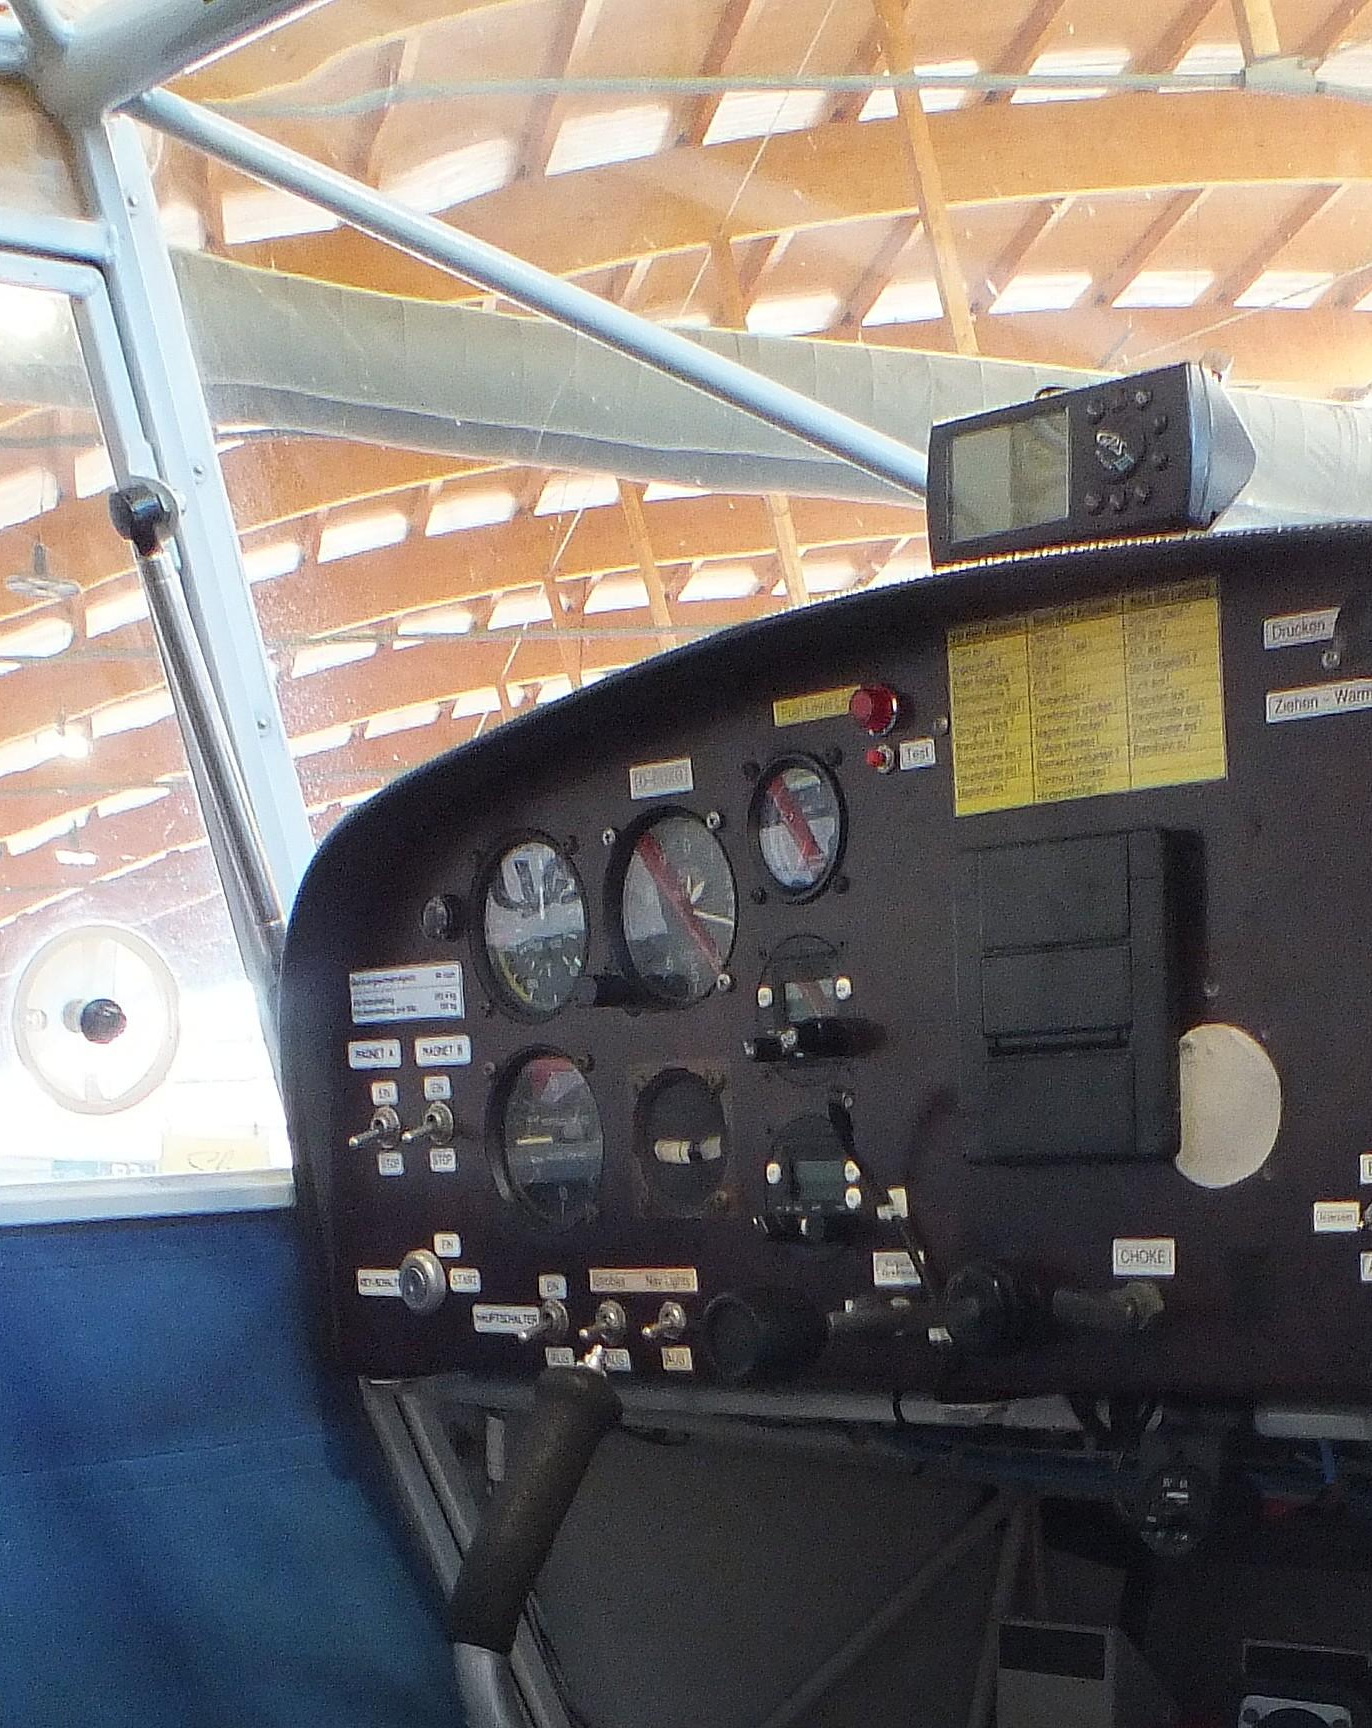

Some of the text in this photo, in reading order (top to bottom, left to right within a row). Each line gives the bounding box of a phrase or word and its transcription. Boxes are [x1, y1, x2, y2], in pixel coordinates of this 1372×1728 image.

[1274, 696, 1318, 715] Ziehen
[433, 1154, 453, 1166] STOP
[1120, 1248, 1166, 1265] CHOKE
[452, 1274, 478, 1286] START
